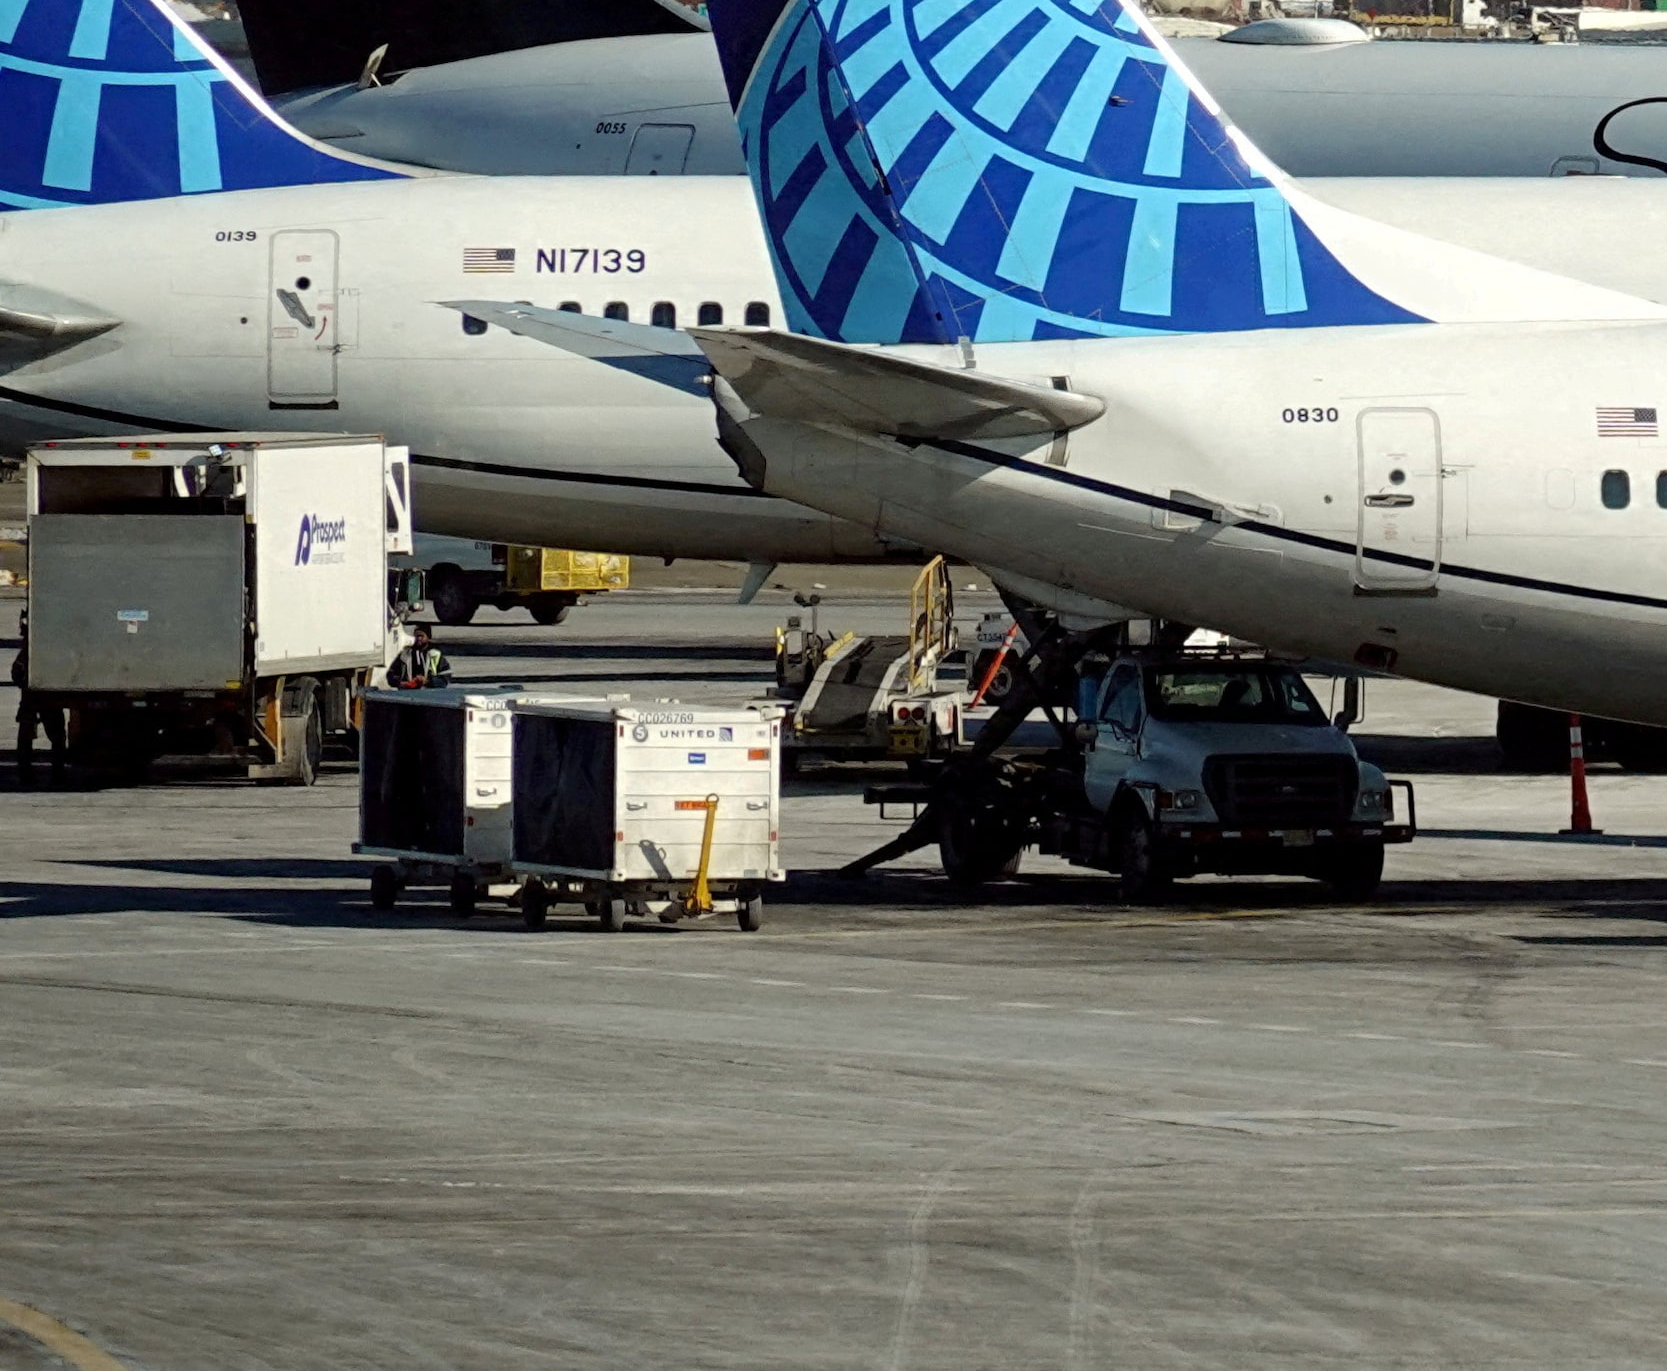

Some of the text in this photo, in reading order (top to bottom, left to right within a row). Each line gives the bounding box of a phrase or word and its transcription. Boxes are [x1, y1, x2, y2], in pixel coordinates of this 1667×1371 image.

[596, 122, 627, 134] 0055
[215, 231, 257, 242] 0139
[536, 248, 645, 274] N17139
[1282, 407, 1339, 423] 0830
[311, 513, 345, 551] Prospect
[638, 713, 694, 725] CC026769
[660, 730, 715, 738] UNITED
